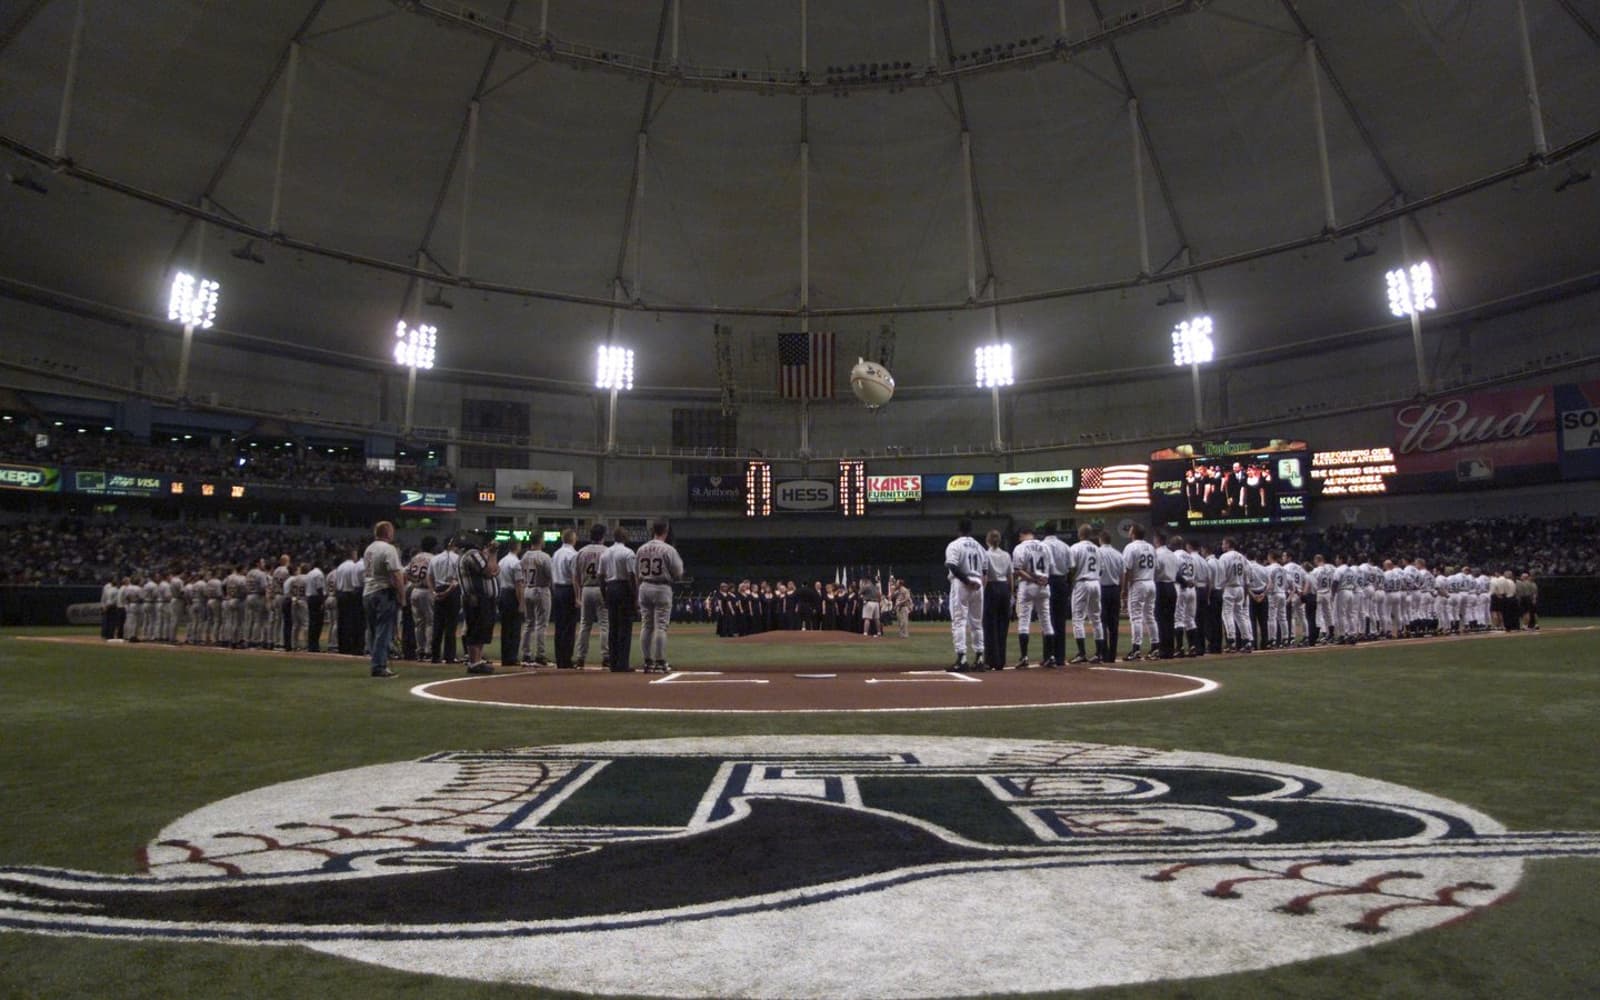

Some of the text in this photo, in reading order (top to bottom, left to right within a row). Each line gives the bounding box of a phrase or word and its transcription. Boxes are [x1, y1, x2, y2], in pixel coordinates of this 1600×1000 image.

[1397, 393, 1545, 454] Bud
[1312, 456, 1355, 466] NATIONAL
[868, 477, 921, 491] KANE'S
[1026, 475, 1069, 484] CHEVROLET
[1153, 480, 1182, 490] PEPSI
[782, 487, 828, 501] HESS
[1280, 496, 1303, 504] KMC
[640, 558, 663, 577] 33
[968, 553, 978, 571] 11
[1029, 556, 1045, 573] 14
[1088, 556, 1097, 572] 2
[1139, 554, 1154, 569] 28
[408, 564, 428, 580] 26
[587, 563, 598, 579] 4
[1181, 563, 1194, 577] 23
[1233, 563, 1244, 576] 18
